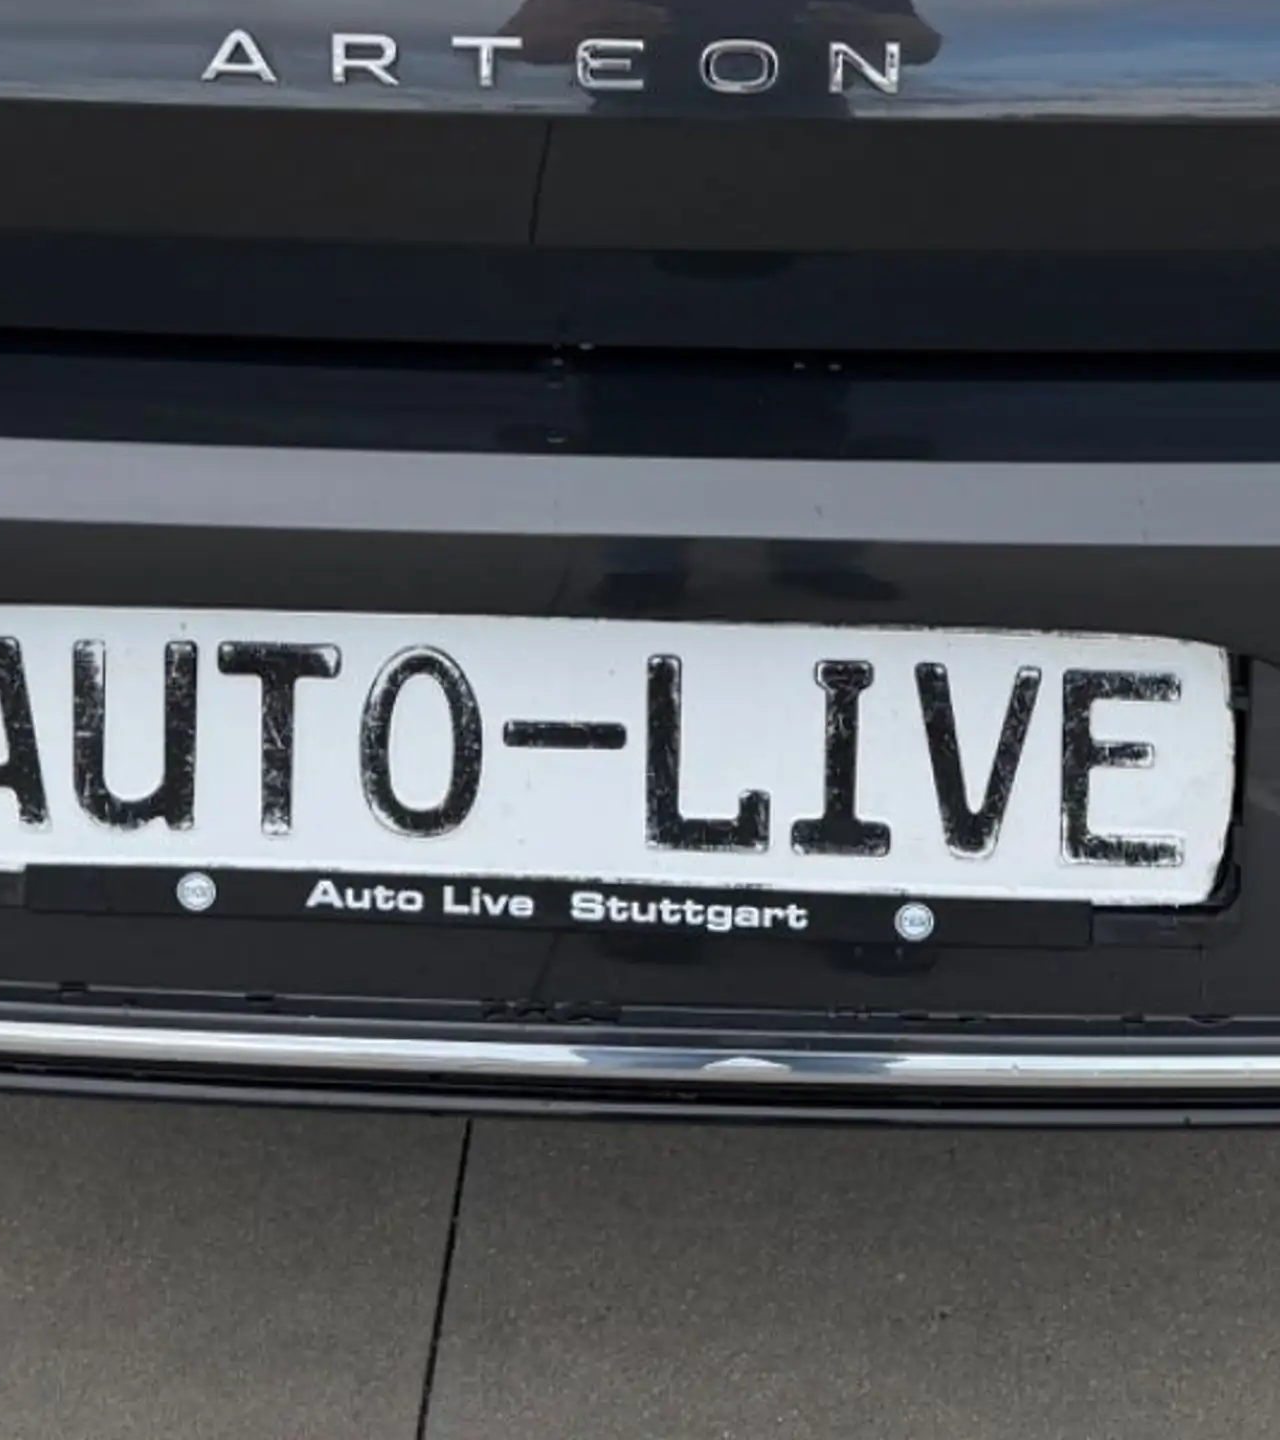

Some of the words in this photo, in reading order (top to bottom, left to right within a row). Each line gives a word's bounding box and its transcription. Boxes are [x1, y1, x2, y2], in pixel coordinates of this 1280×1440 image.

[202, 28, 903, 96] ARTEON
[305, 879, 424, 912] Auto
[443, 885, 535, 917] Live
[570, 890, 809, 933] Stuttgart
